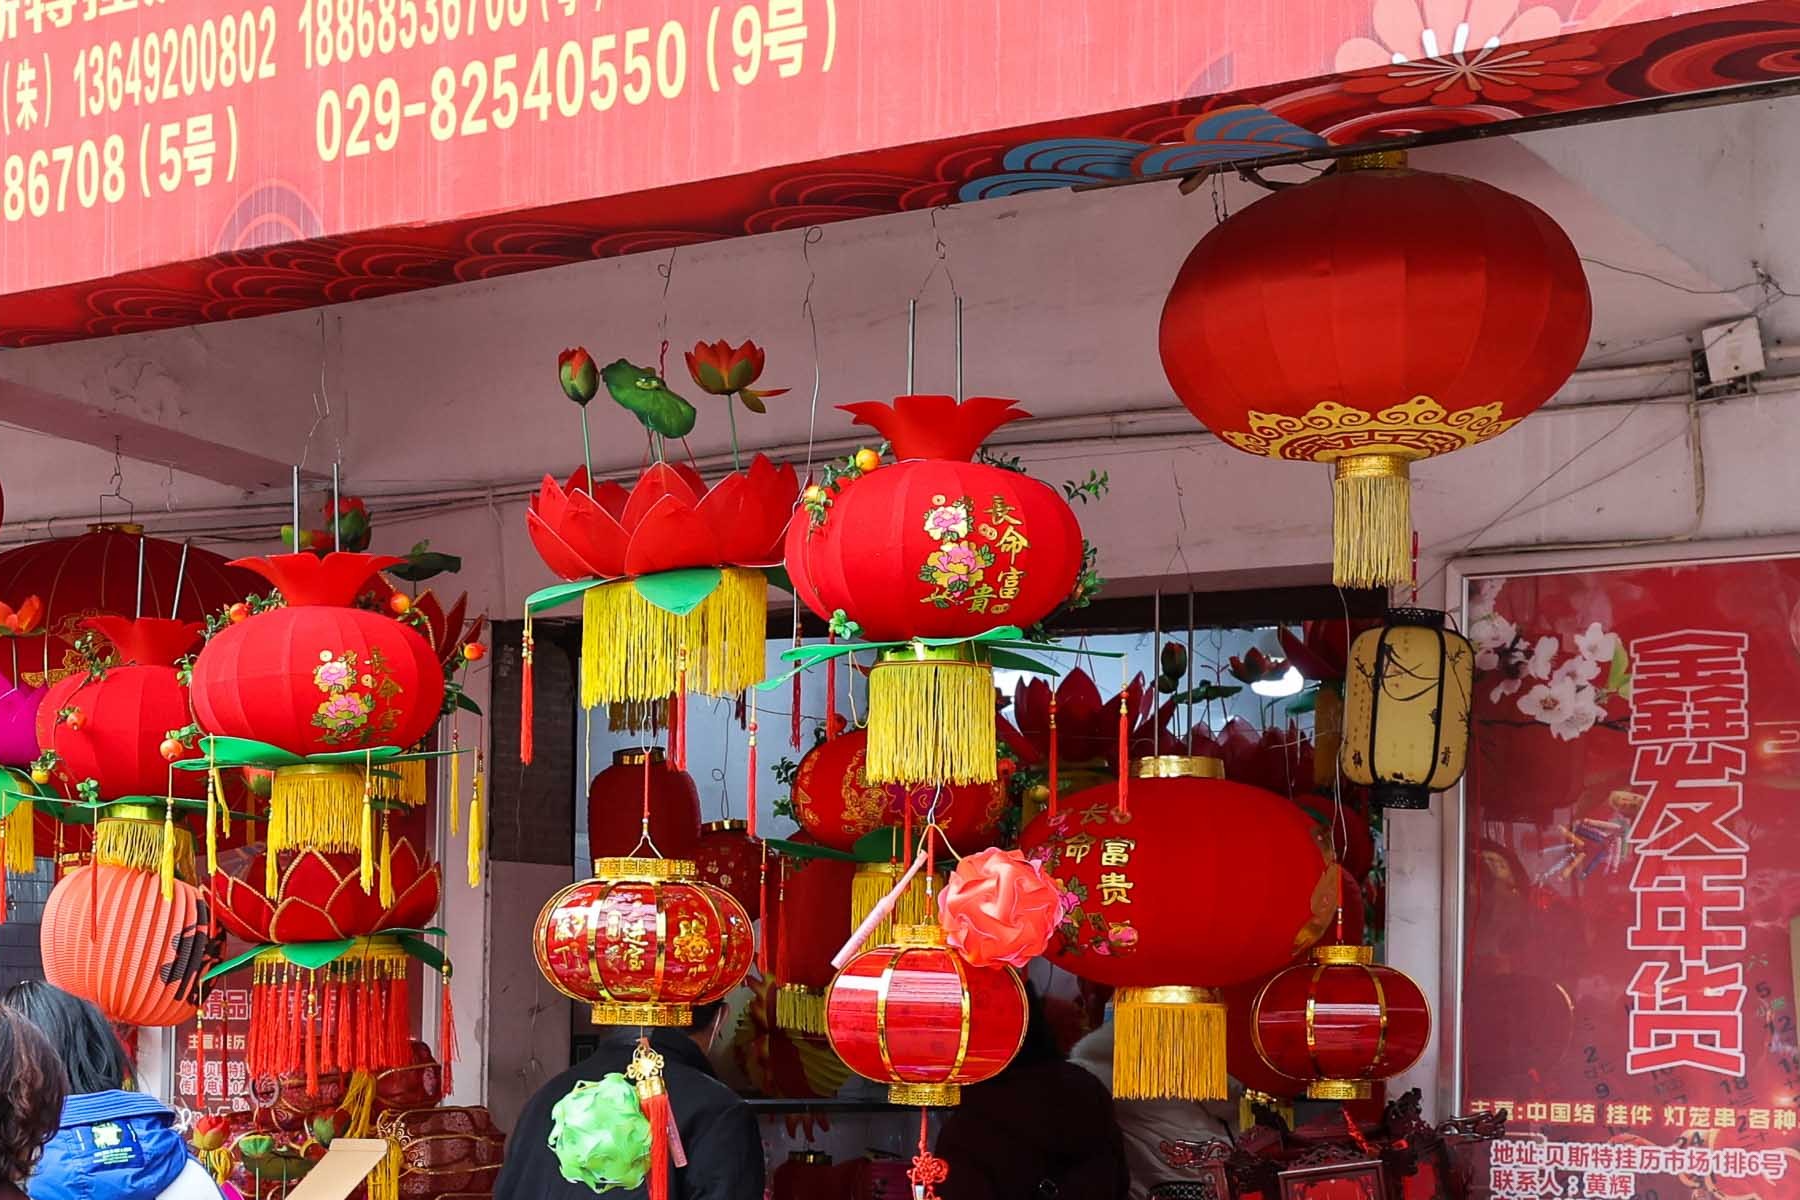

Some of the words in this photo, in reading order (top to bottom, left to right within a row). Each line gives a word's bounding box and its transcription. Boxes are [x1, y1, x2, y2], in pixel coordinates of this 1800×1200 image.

[74, 10, 277, 118] 13649200802
[1627, 629, 1750, 1077] 鑫发年货
[1606, 1104, 1652, 1126] 挂件
[1663, 1105, 1738, 1129] 灯笼串
[1490, 1141, 1786, 1178] 地址:贝斯特挂历市场1排6号
